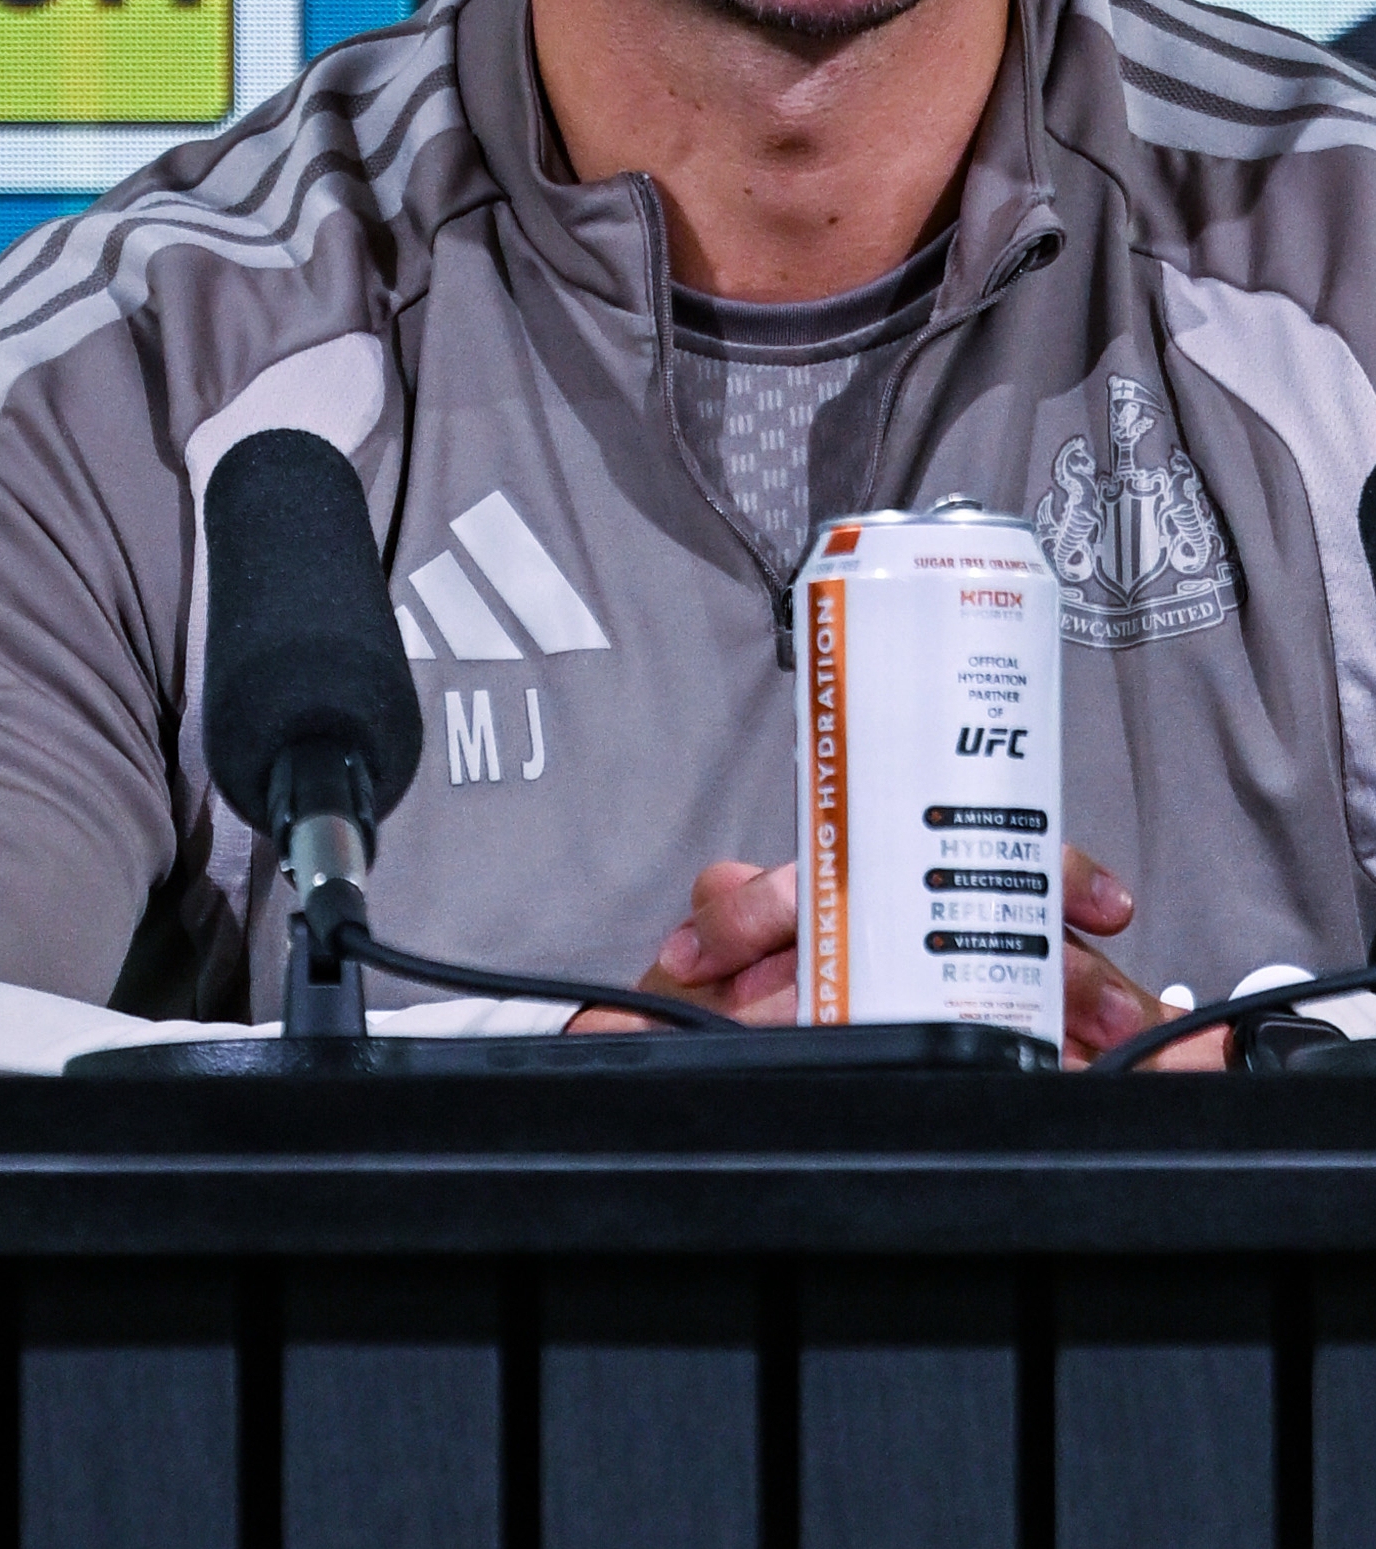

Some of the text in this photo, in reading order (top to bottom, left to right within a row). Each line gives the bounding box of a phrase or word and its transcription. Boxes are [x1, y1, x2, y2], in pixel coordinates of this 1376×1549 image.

[1060, 601, 1214, 638] EWCASTLE UNITED
[968, 656, 1019, 669] OFFICIAL
[957, 673, 1027, 686] HYDRATION
[968, 690, 1020, 703] PARTNER
[987, 707, 1004, 719] OF
[955, 727, 1029, 759] UFC
[816, 597, 839, 1023] SPARKLING HYDRATION
[953, 813, 1041, 828] AMINO ACIDS
[940, 839, 1041, 862] HYDRATE
[953, 874, 1043, 890] ELECTROLYTES
[931, 902, 1047, 926] REPLENISH
[954, 936, 1023, 951] VITAMINS
[942, 963, 1042, 987] RECOVER
